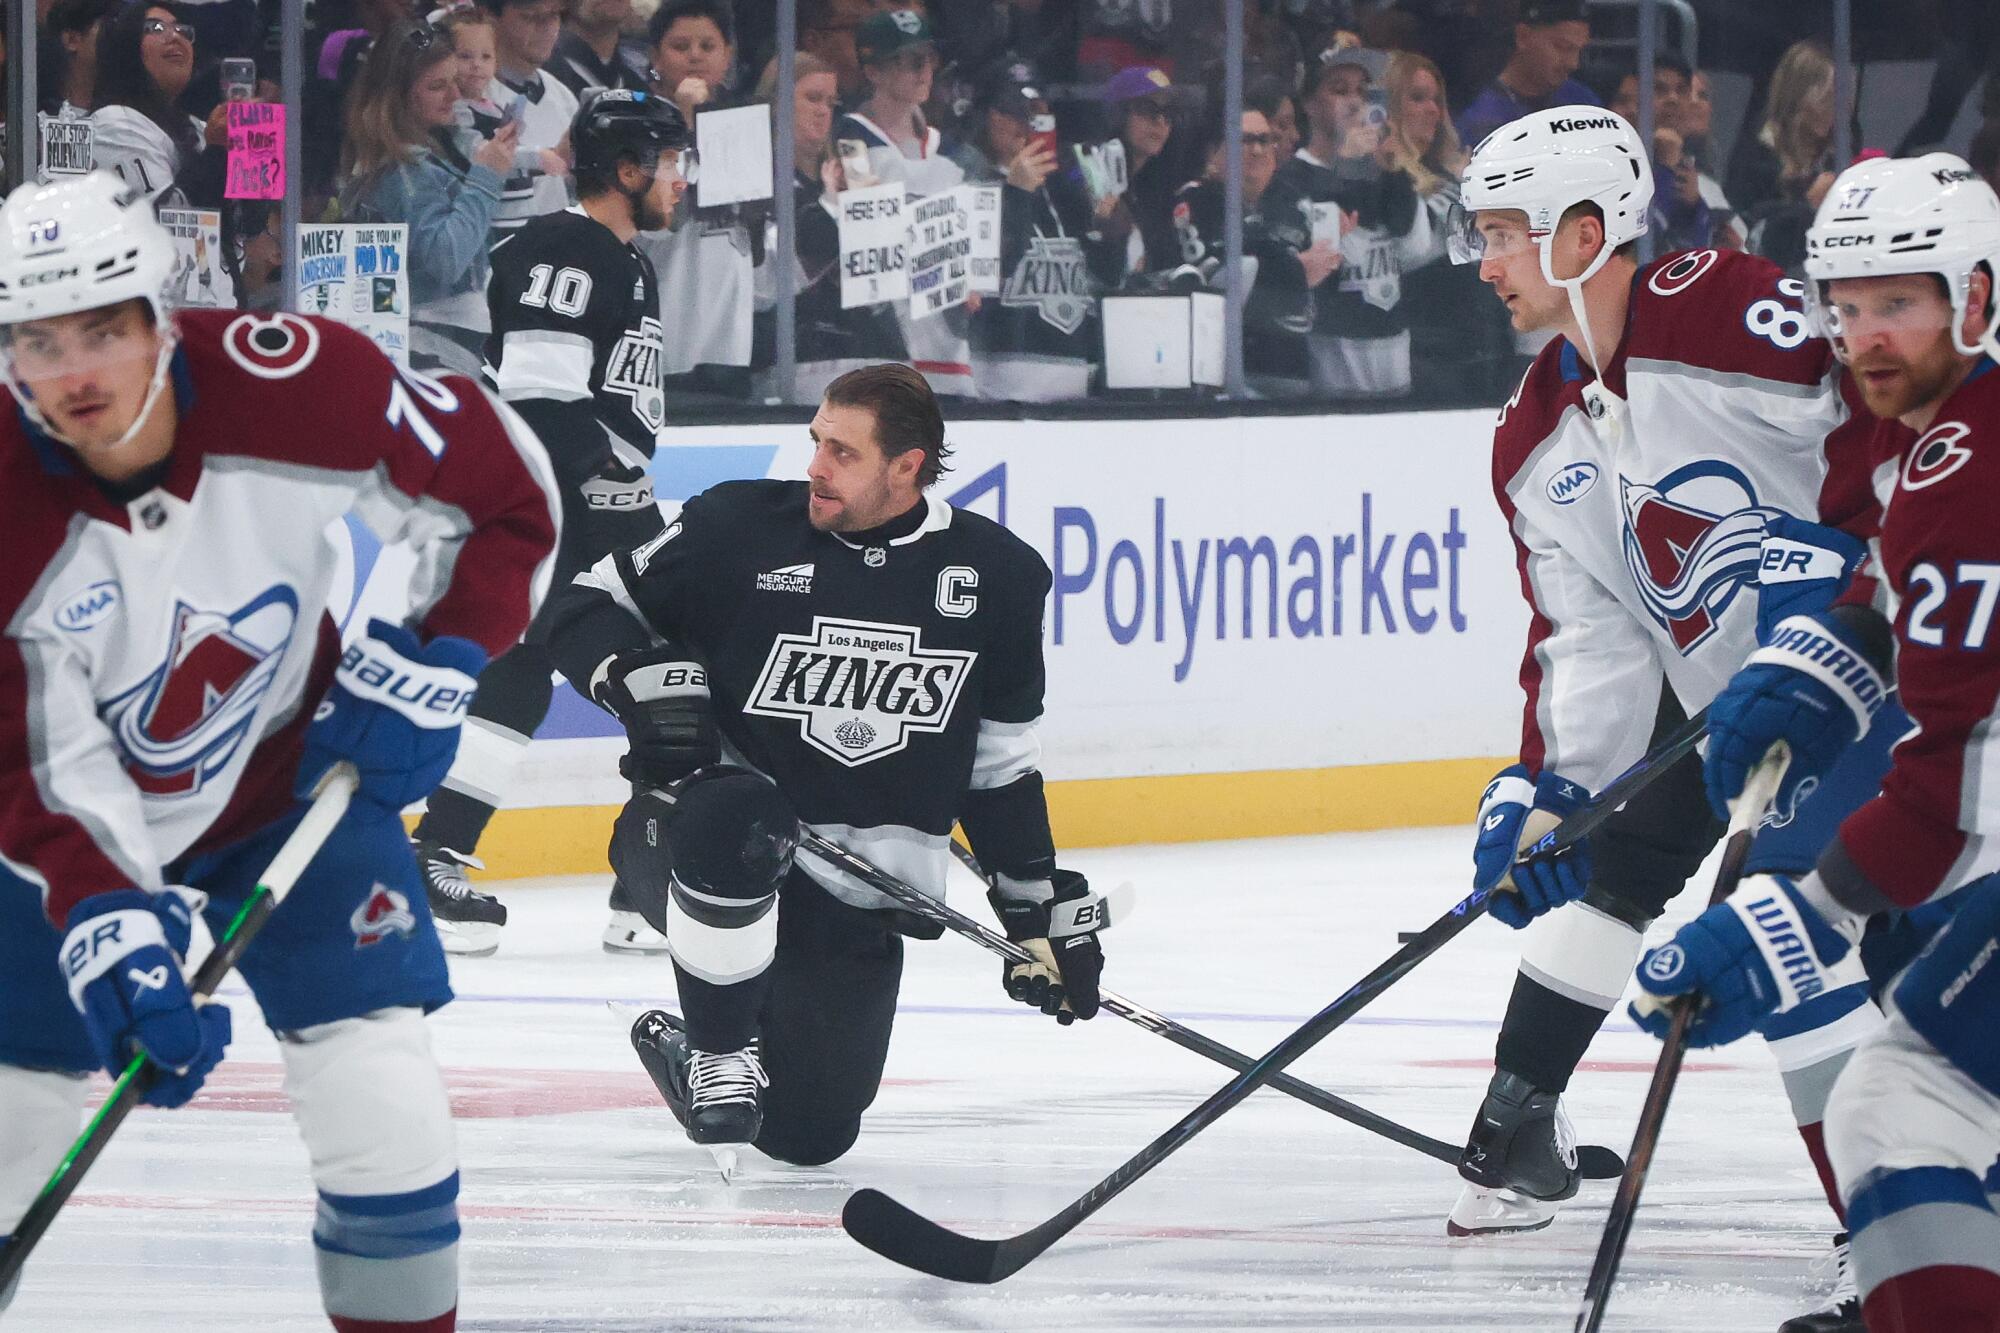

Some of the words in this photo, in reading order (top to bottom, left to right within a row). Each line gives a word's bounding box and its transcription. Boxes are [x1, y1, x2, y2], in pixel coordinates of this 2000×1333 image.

[1549, 116, 1620, 134] Kiewit
[301, 230, 344, 259] MIKEY
[376, 230, 389, 243] YOU
[1824, 234, 1875, 248] CCM
[520, 264, 593, 318] 10
[1552, 470, 1591, 498] IMA
[587, 489, 653, 506] CCM
[756, 582, 811, 594] INSURANCE
[757, 573, 812, 586] MERCURY
[1053, 493, 1467, 683] Polymarket
[935, 565, 978, 618] C
[1908, 562, 2000, 650] 27
[828, 634, 850, 647] Los
[853, 635, 904, 653] Angeles
[770, 651, 954, 717] KINGS
